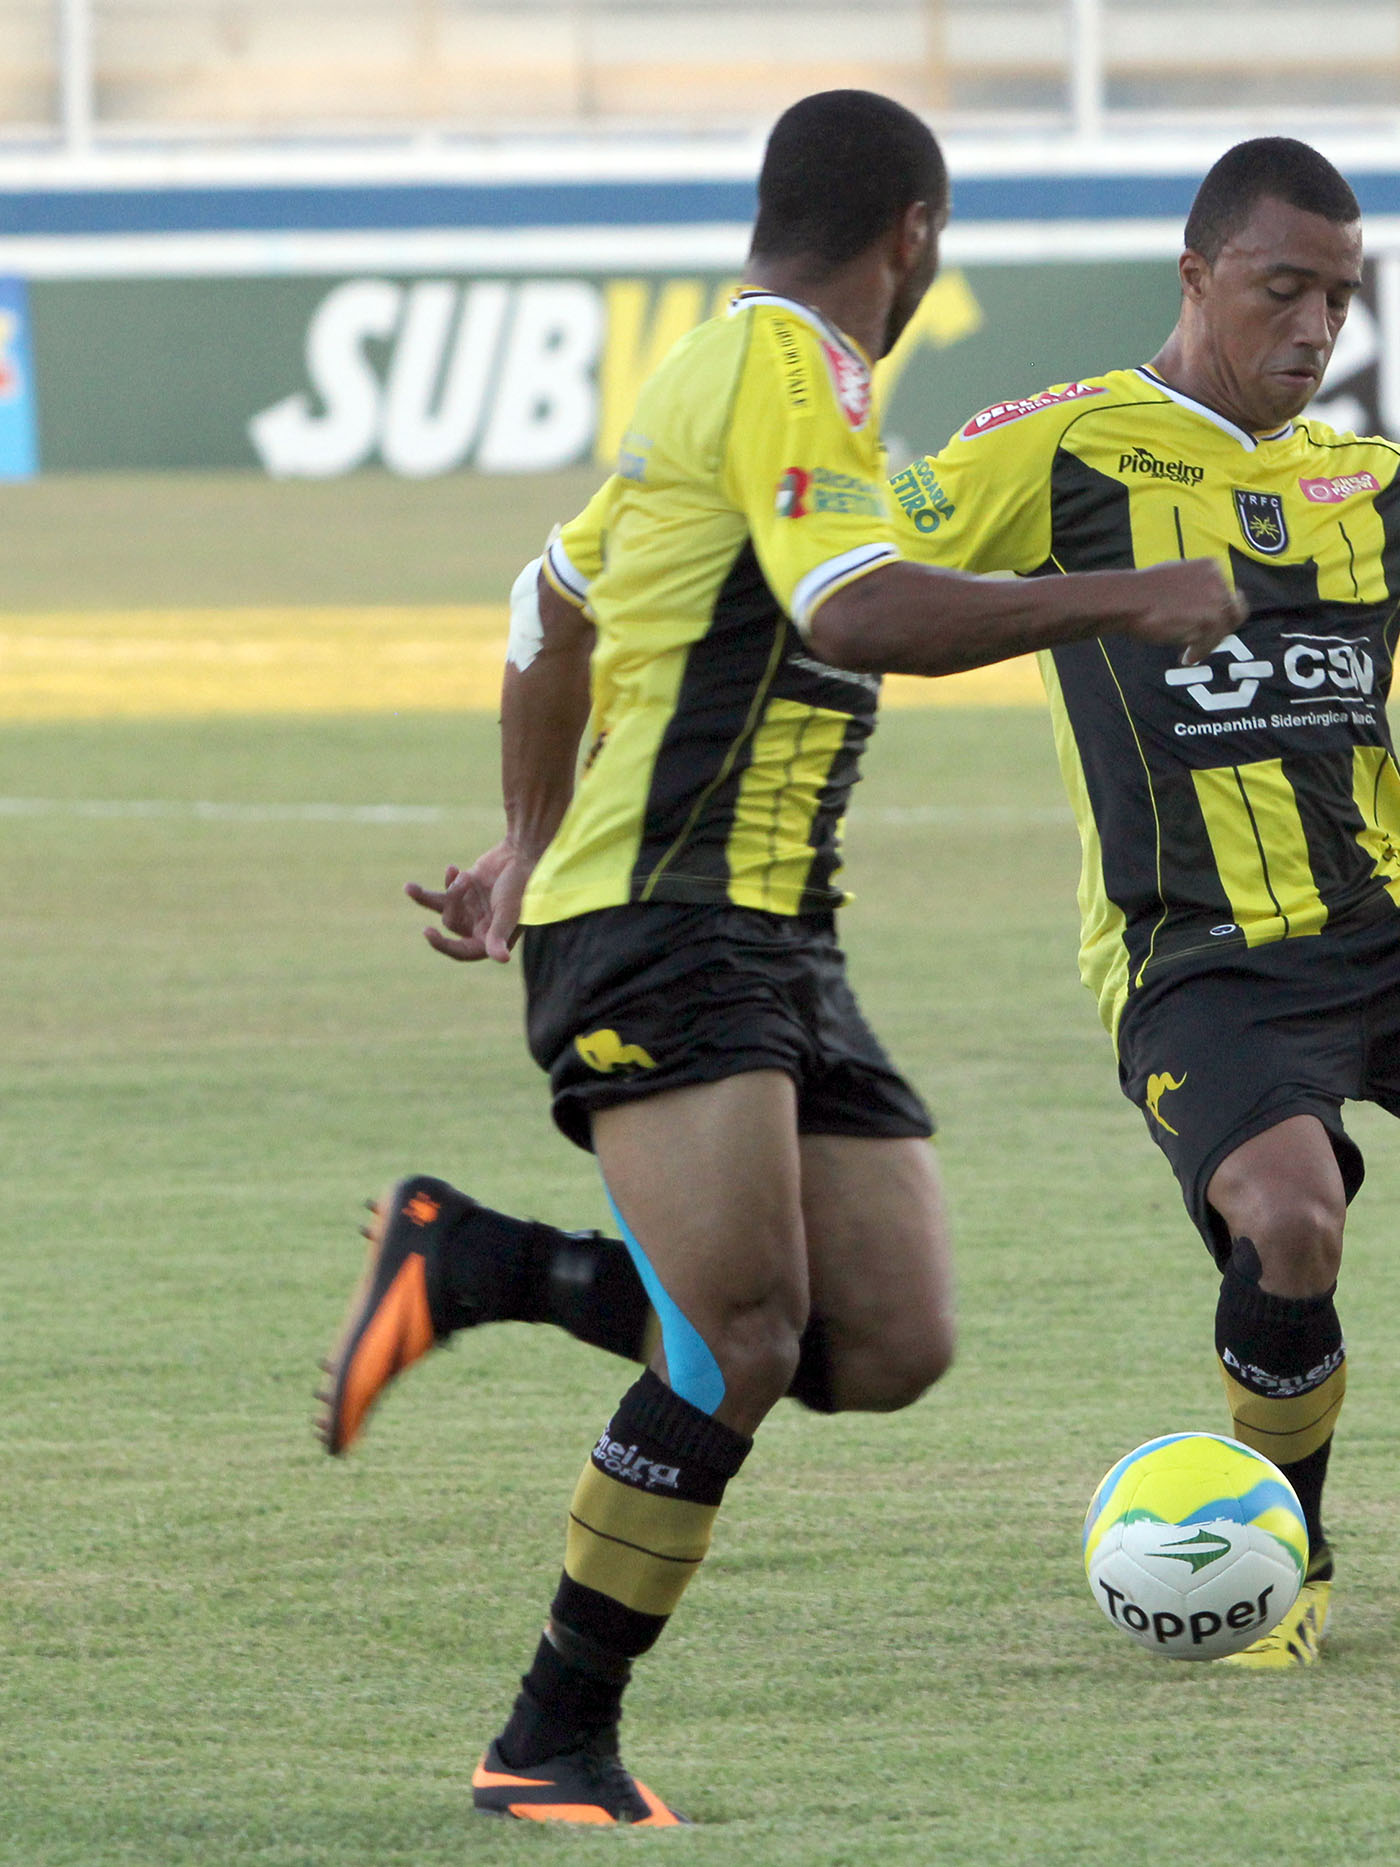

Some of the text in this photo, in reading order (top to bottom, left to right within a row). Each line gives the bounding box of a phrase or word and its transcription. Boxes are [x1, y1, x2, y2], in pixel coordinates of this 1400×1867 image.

[1118, 449, 1204, 482] Pioneira
[1237, 493, 1279, 508] VRFC
[1174, 716, 1267, 736] Companhia
[1270, 710, 1349, 728] Siderúrgica
[1098, 1577, 1275, 1645] Topper
